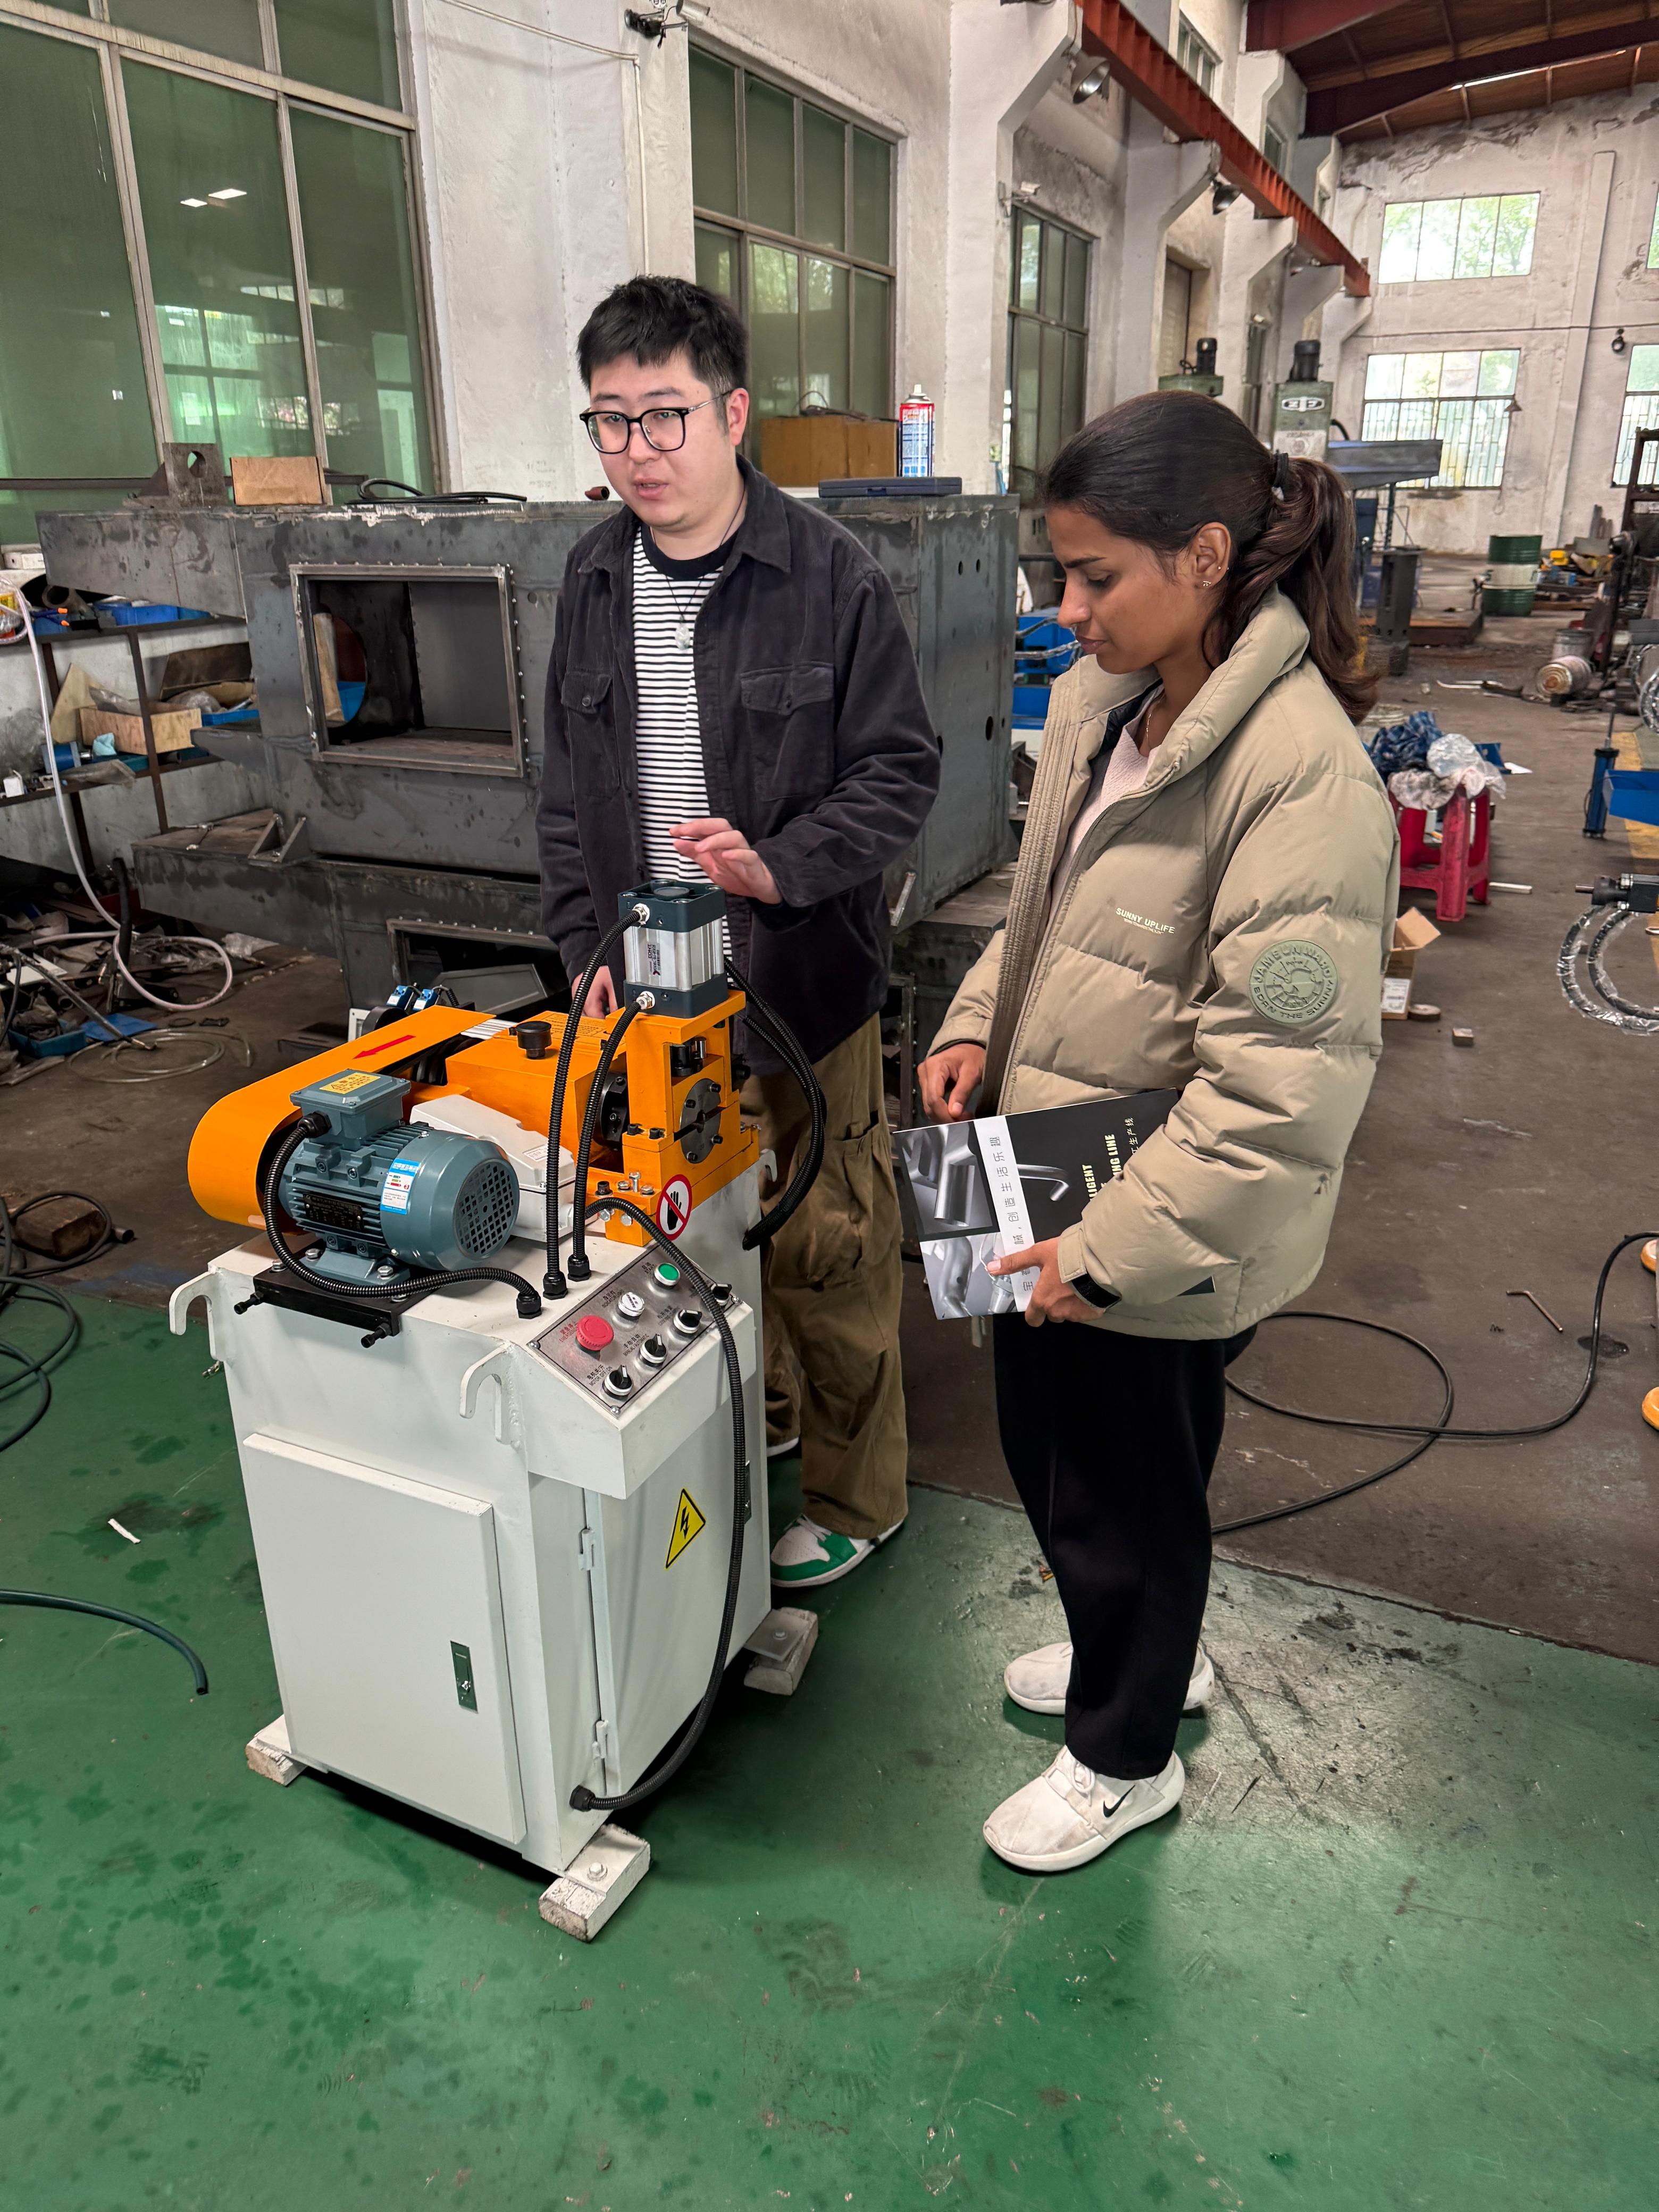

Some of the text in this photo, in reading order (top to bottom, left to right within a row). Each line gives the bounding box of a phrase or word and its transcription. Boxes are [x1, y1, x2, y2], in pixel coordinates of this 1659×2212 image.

[1116, 907, 1143, 923] SUNNY
[1144, 918, 1176, 934] UPLIFE
[1253, 986, 1276, 1013] BORN
[1306, 980, 1334, 1016] SUNNY
[1104, 1134, 1119, 1156] LINE
